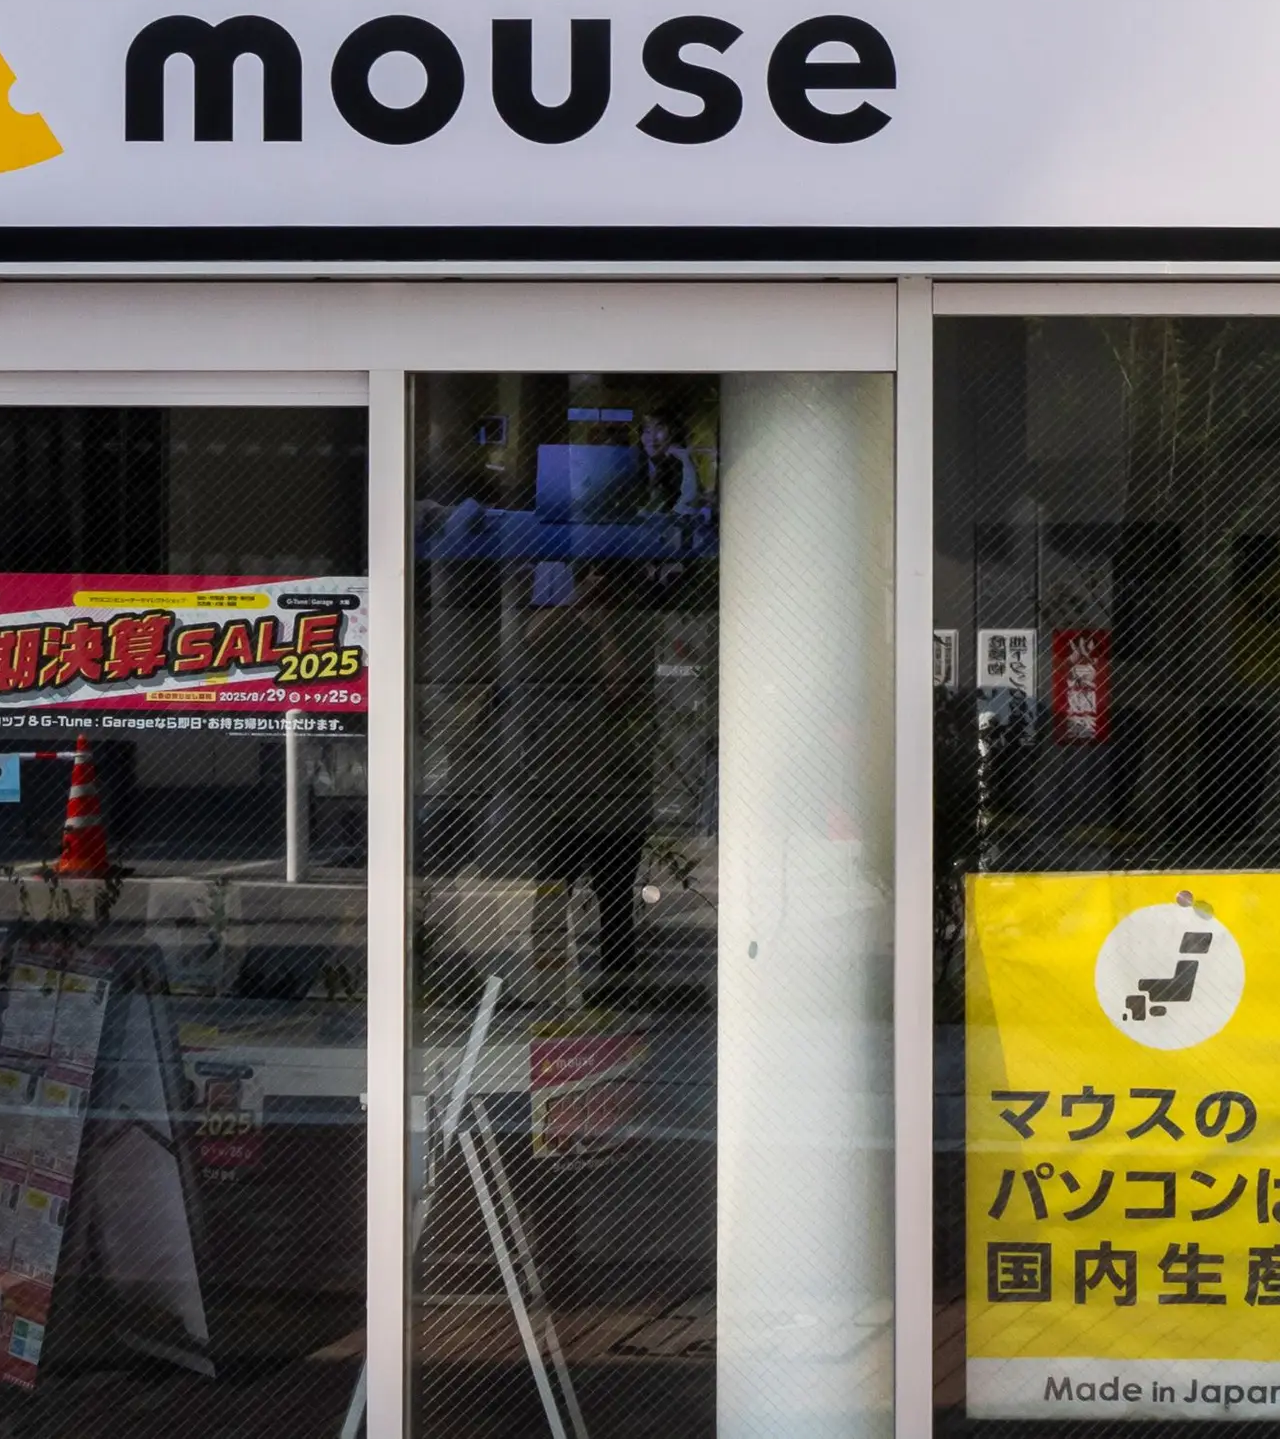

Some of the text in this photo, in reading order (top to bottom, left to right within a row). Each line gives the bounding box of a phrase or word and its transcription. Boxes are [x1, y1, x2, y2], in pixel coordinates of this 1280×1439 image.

[125, 13, 898, 145] mouse
[280, 650, 360, 682] 2025
[219, 688, 286, 704] 2025/8/29
[990, 1085, 1258, 1144] マウスの
[1043, 1376, 1143, 1403] Made
[1152, 1380, 1176, 1403] in
